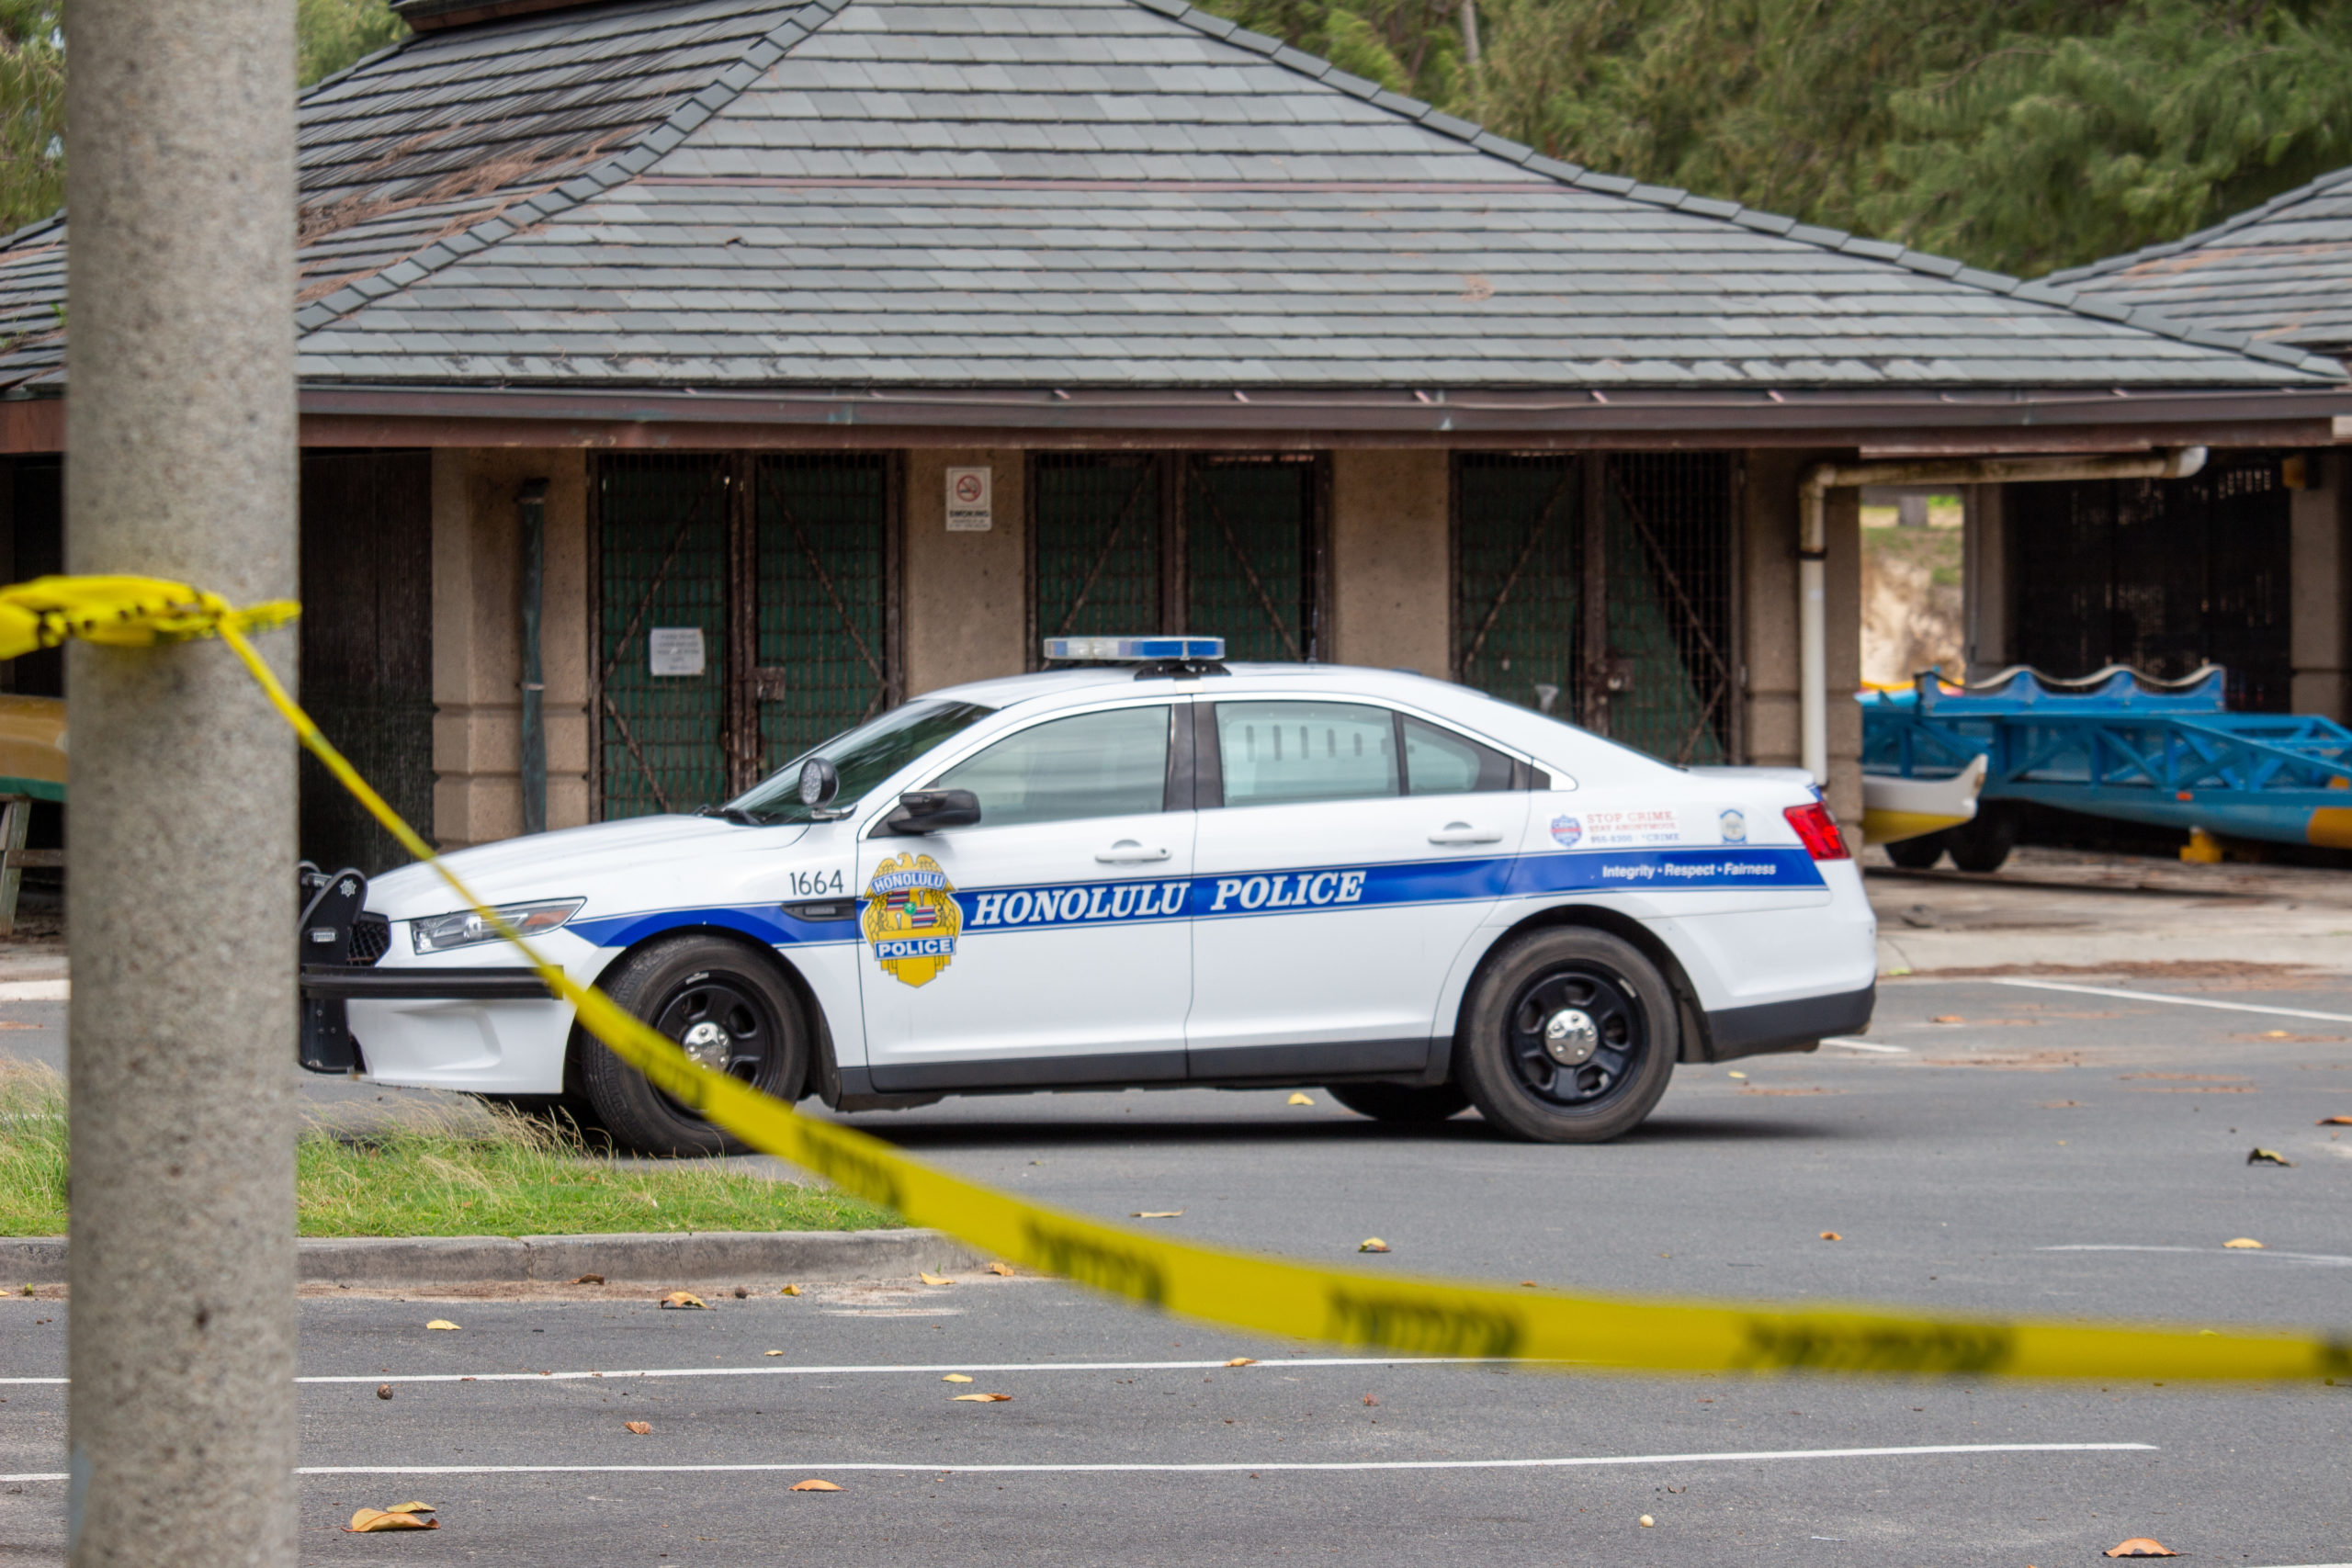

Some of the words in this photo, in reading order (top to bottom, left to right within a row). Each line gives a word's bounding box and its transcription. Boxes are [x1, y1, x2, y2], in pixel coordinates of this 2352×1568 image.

[1587, 813, 1623, 824] STOP
[1602, 865, 1655, 880] Integrity
[1664, 863, 1714, 878] Respect
[1724, 862, 1776, 875] Fairness
[789, 869, 843, 897] 1664
[875, 873, 944, 893] HONOLULU
[970, 882, 1191, 926] HONOLULU
[1210, 871, 1366, 910] POLICE
[878, 939, 952, 957] POLICE
